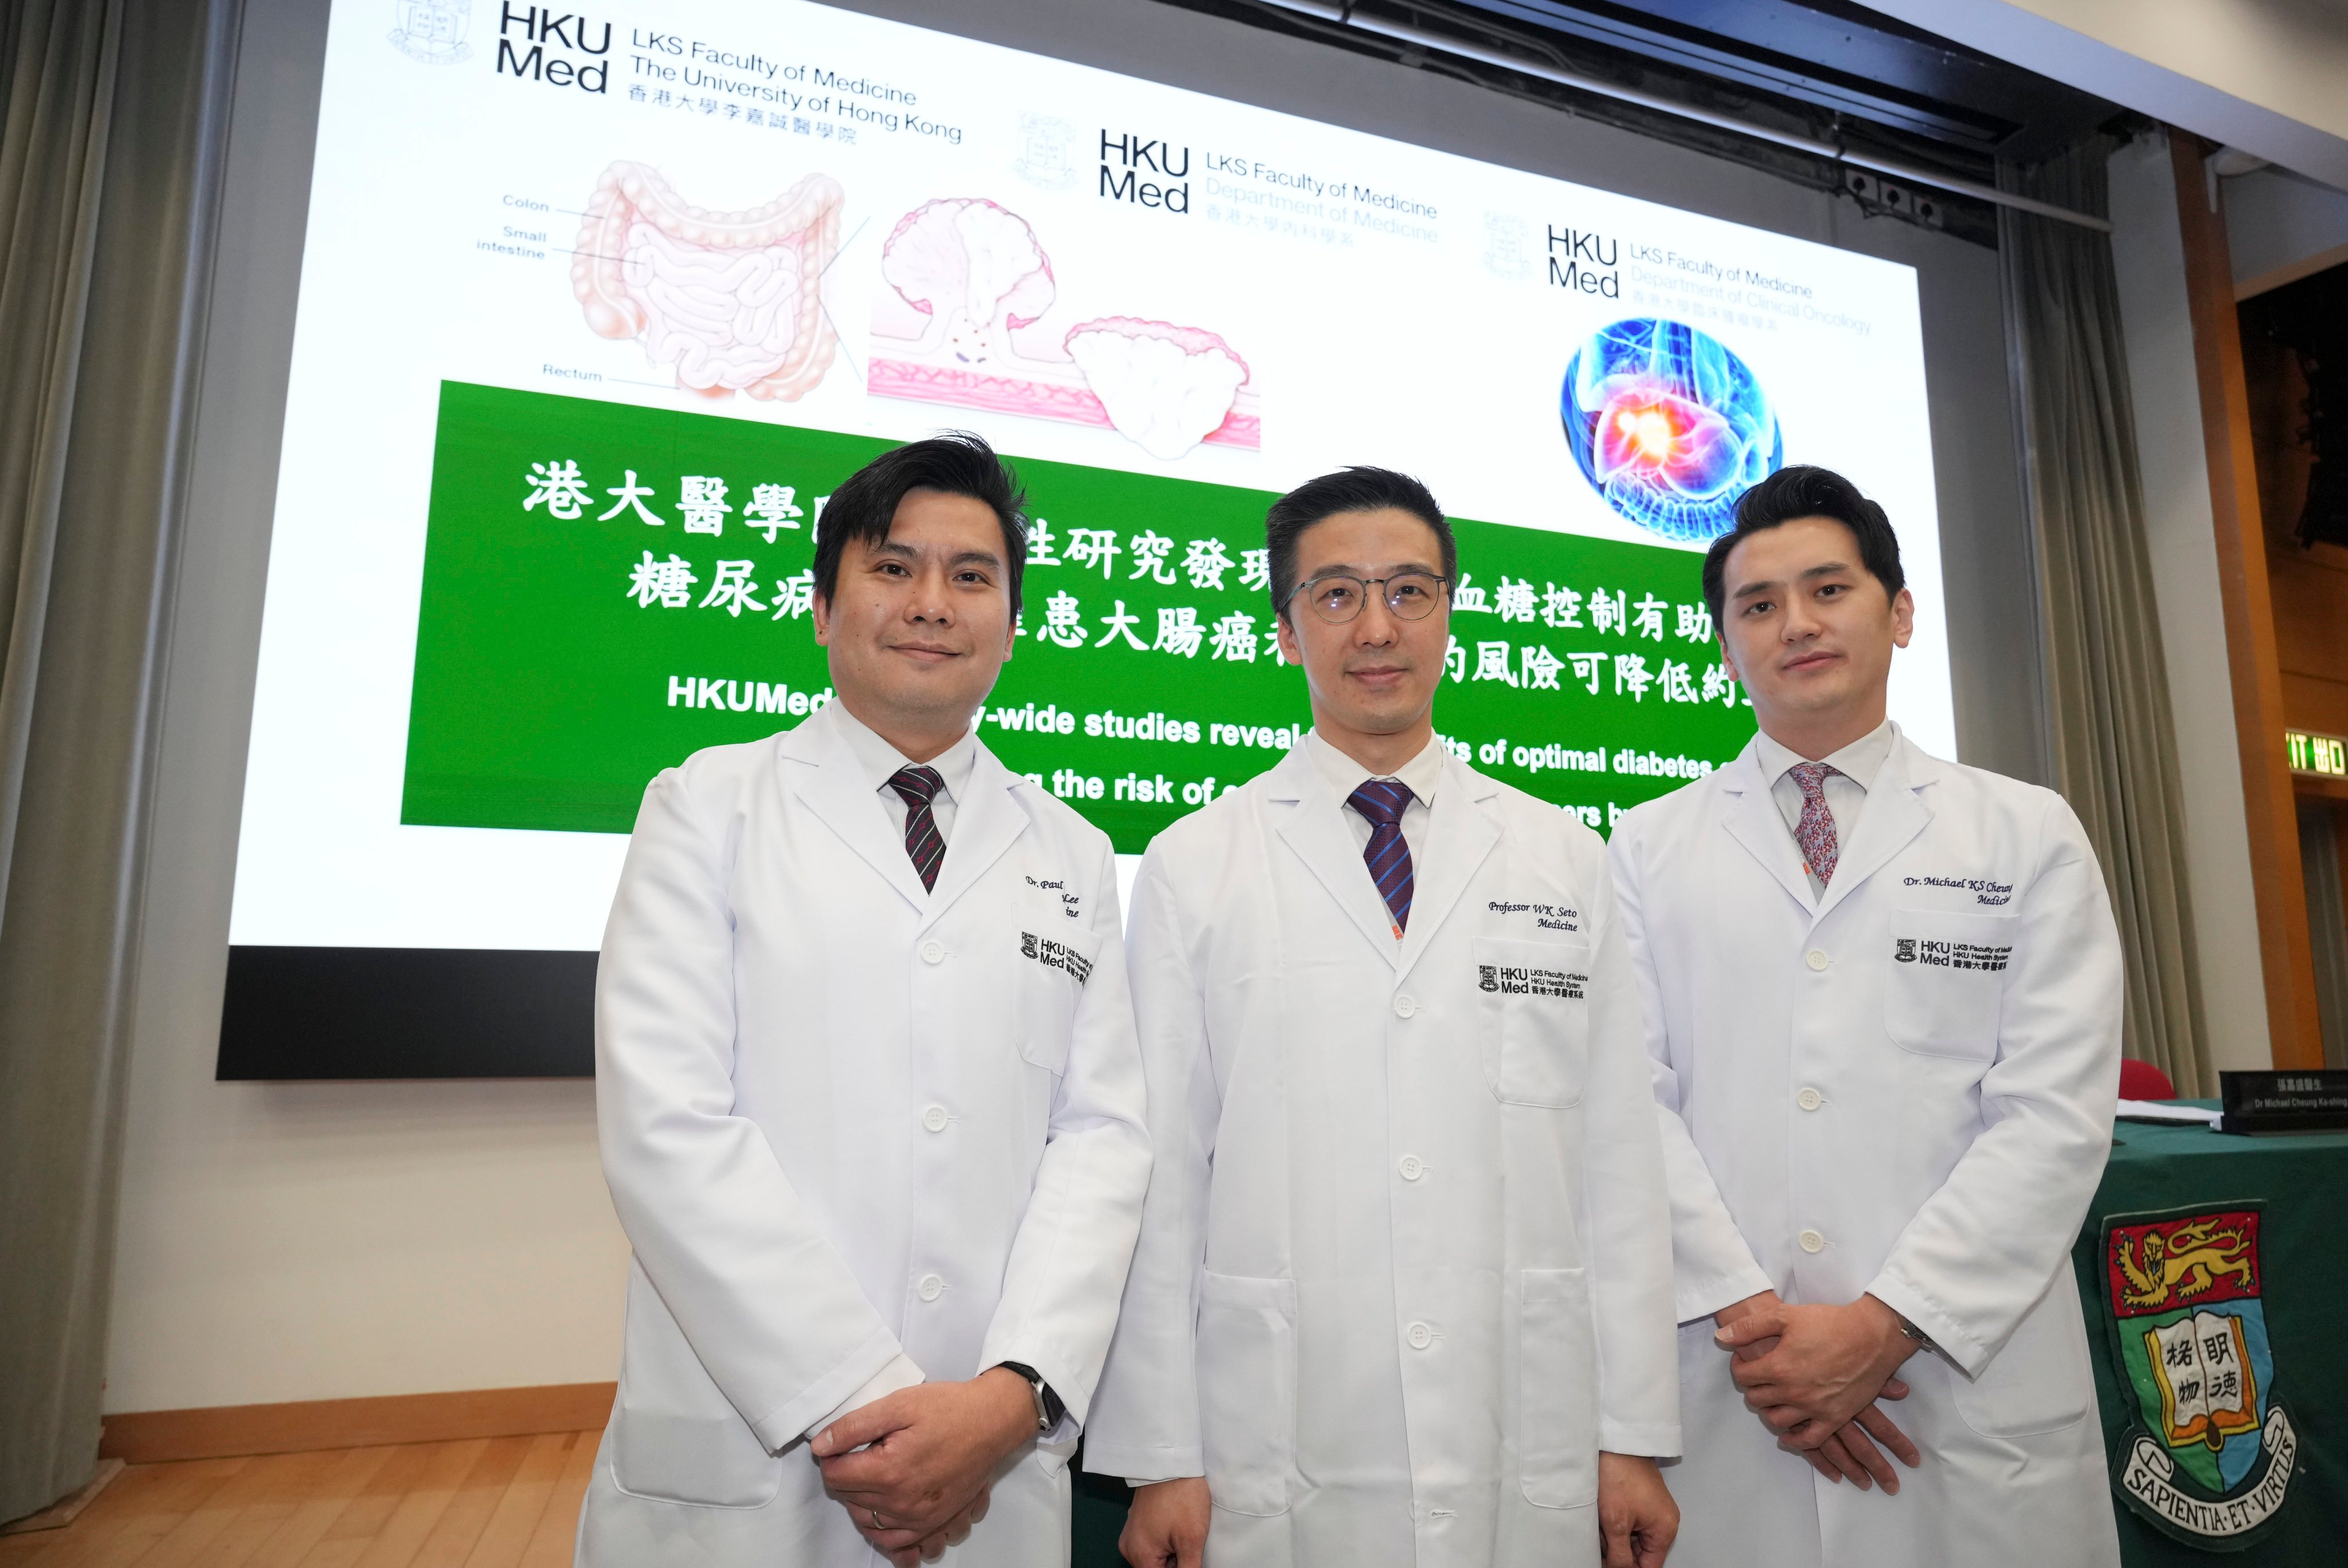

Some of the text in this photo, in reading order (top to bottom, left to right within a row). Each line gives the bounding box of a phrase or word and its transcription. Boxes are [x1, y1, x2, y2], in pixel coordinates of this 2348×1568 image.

[500, 0, 611, 54] HKU
[497, 38, 608, 94] Med
[633, 29, 917, 105] LKS Faculty of Medicine
[631, 54, 962, 145] The University of Hong Kong
[629, 83, 858, 146] 香港大學李嘉誠醫學院
[1101, 128, 1189, 177] HKU
[1100, 164, 1189, 214] Med
[1206, 152, 1437, 219] LKS Faculty of Medicine
[503, 194, 549, 212] Colon
[1207, 178, 1438, 243] Department of Medicine
[503, 226, 546, 242] Small
[477, 239, 545, 260] intestine
[1548, 224, 1618, 266] HKU
[1549, 257, 1619, 300] Med
[1630, 243, 1812, 299] LKS Faculty of Medicine
[1631, 266, 1871, 336] Department of Clinical Oncology
[543, 364, 602, 382] Rectum
[523, 459, 831, 544] 港大醫學
[1015, 589, 1284, 667] 患大腸癌
[1441, 634, 1752, 708] 的風險可降低約
[1084, 710, 1200, 743] studies
[1210, 723, 1300, 750] reveal
[1479, 738, 1508, 765] of
[1513, 743, 1606, 773] optimal
[1613, 748, 1712, 779] diabetes
[2312, 736, 2346, 775] 出口
[1052, 769, 1105, 800] the
[1114, 773, 1174, 803] risk
[1182, 777, 1215, 805] of
[1026, 876, 1063, 889] Dr. Paul
[1903, 877, 1922, 886] Dr.
[1924, 877, 1967, 888] Michael
[1968, 880, 1985, 892] KS
[1489, 901, 1577, 918] Professor WK Seto
[1537, 918, 1578, 932] Medicine
[1041, 939, 1065, 956] HKU
[1067, 947, 1075, 957] LKS
[1075, 952, 1090, 968] Faculty
[1921, 940, 1950, 954] HKU
[1970, 945, 1994, 954] Faculty
[1040, 951, 1065, 969] Med
[1066, 954, 1075, 966] HKU
[1075, 961, 1087, 974] Health
[1920, 953, 1949, 967] Med
[1500, 967, 1528, 981] HKU
[1531, 969, 1543, 977] LKS
[1544, 970, 1566, 980] Faculty
[1572, 974, 1588, 982] Medicine
[1531, 977, 1580, 989] HKU Health System
[1501, 981, 1529, 994] Med
[2255, 1099, 2263, 1108] Dr
[2127, 1435, 2294, 1531] SAPIENTIA ET VIRTUS
